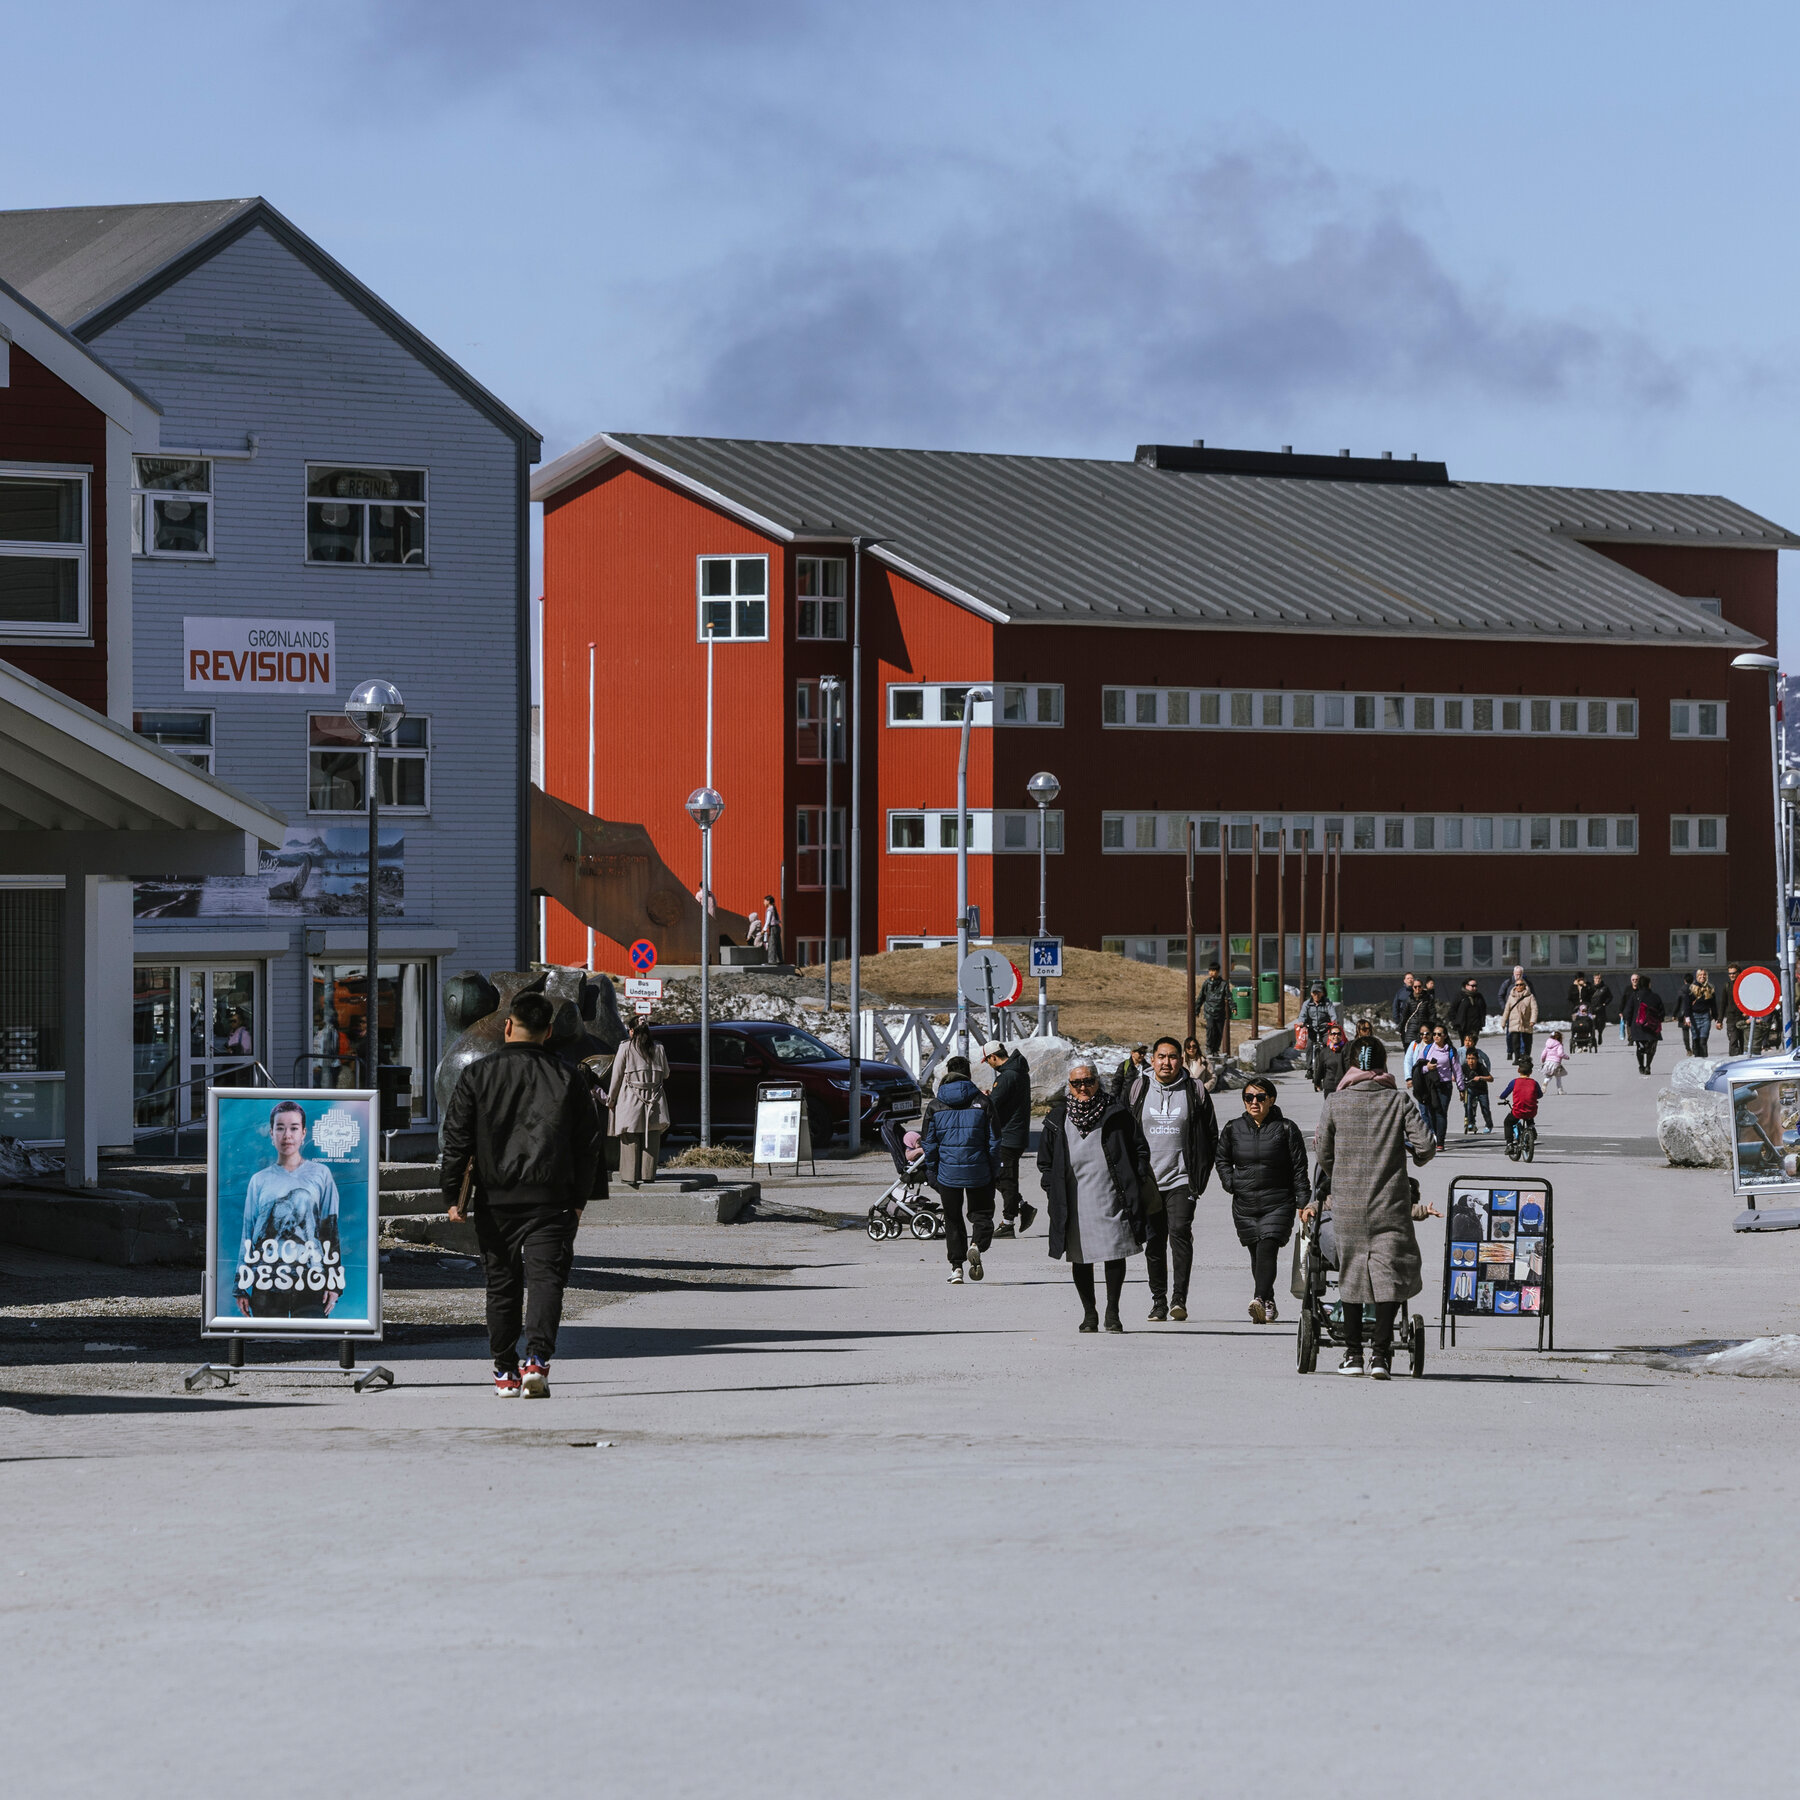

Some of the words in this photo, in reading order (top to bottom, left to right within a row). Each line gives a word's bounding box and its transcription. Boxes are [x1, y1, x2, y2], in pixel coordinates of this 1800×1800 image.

[349, 480, 388, 496] REGINA
[248, 630, 330, 648] GRØNLANDS
[190, 650, 330, 683] REVISION
[1150, 1125, 1180, 1134] adidas
[244, 1238, 340, 1265] LOCAL
[238, 1265, 346, 1291] DESIGN
